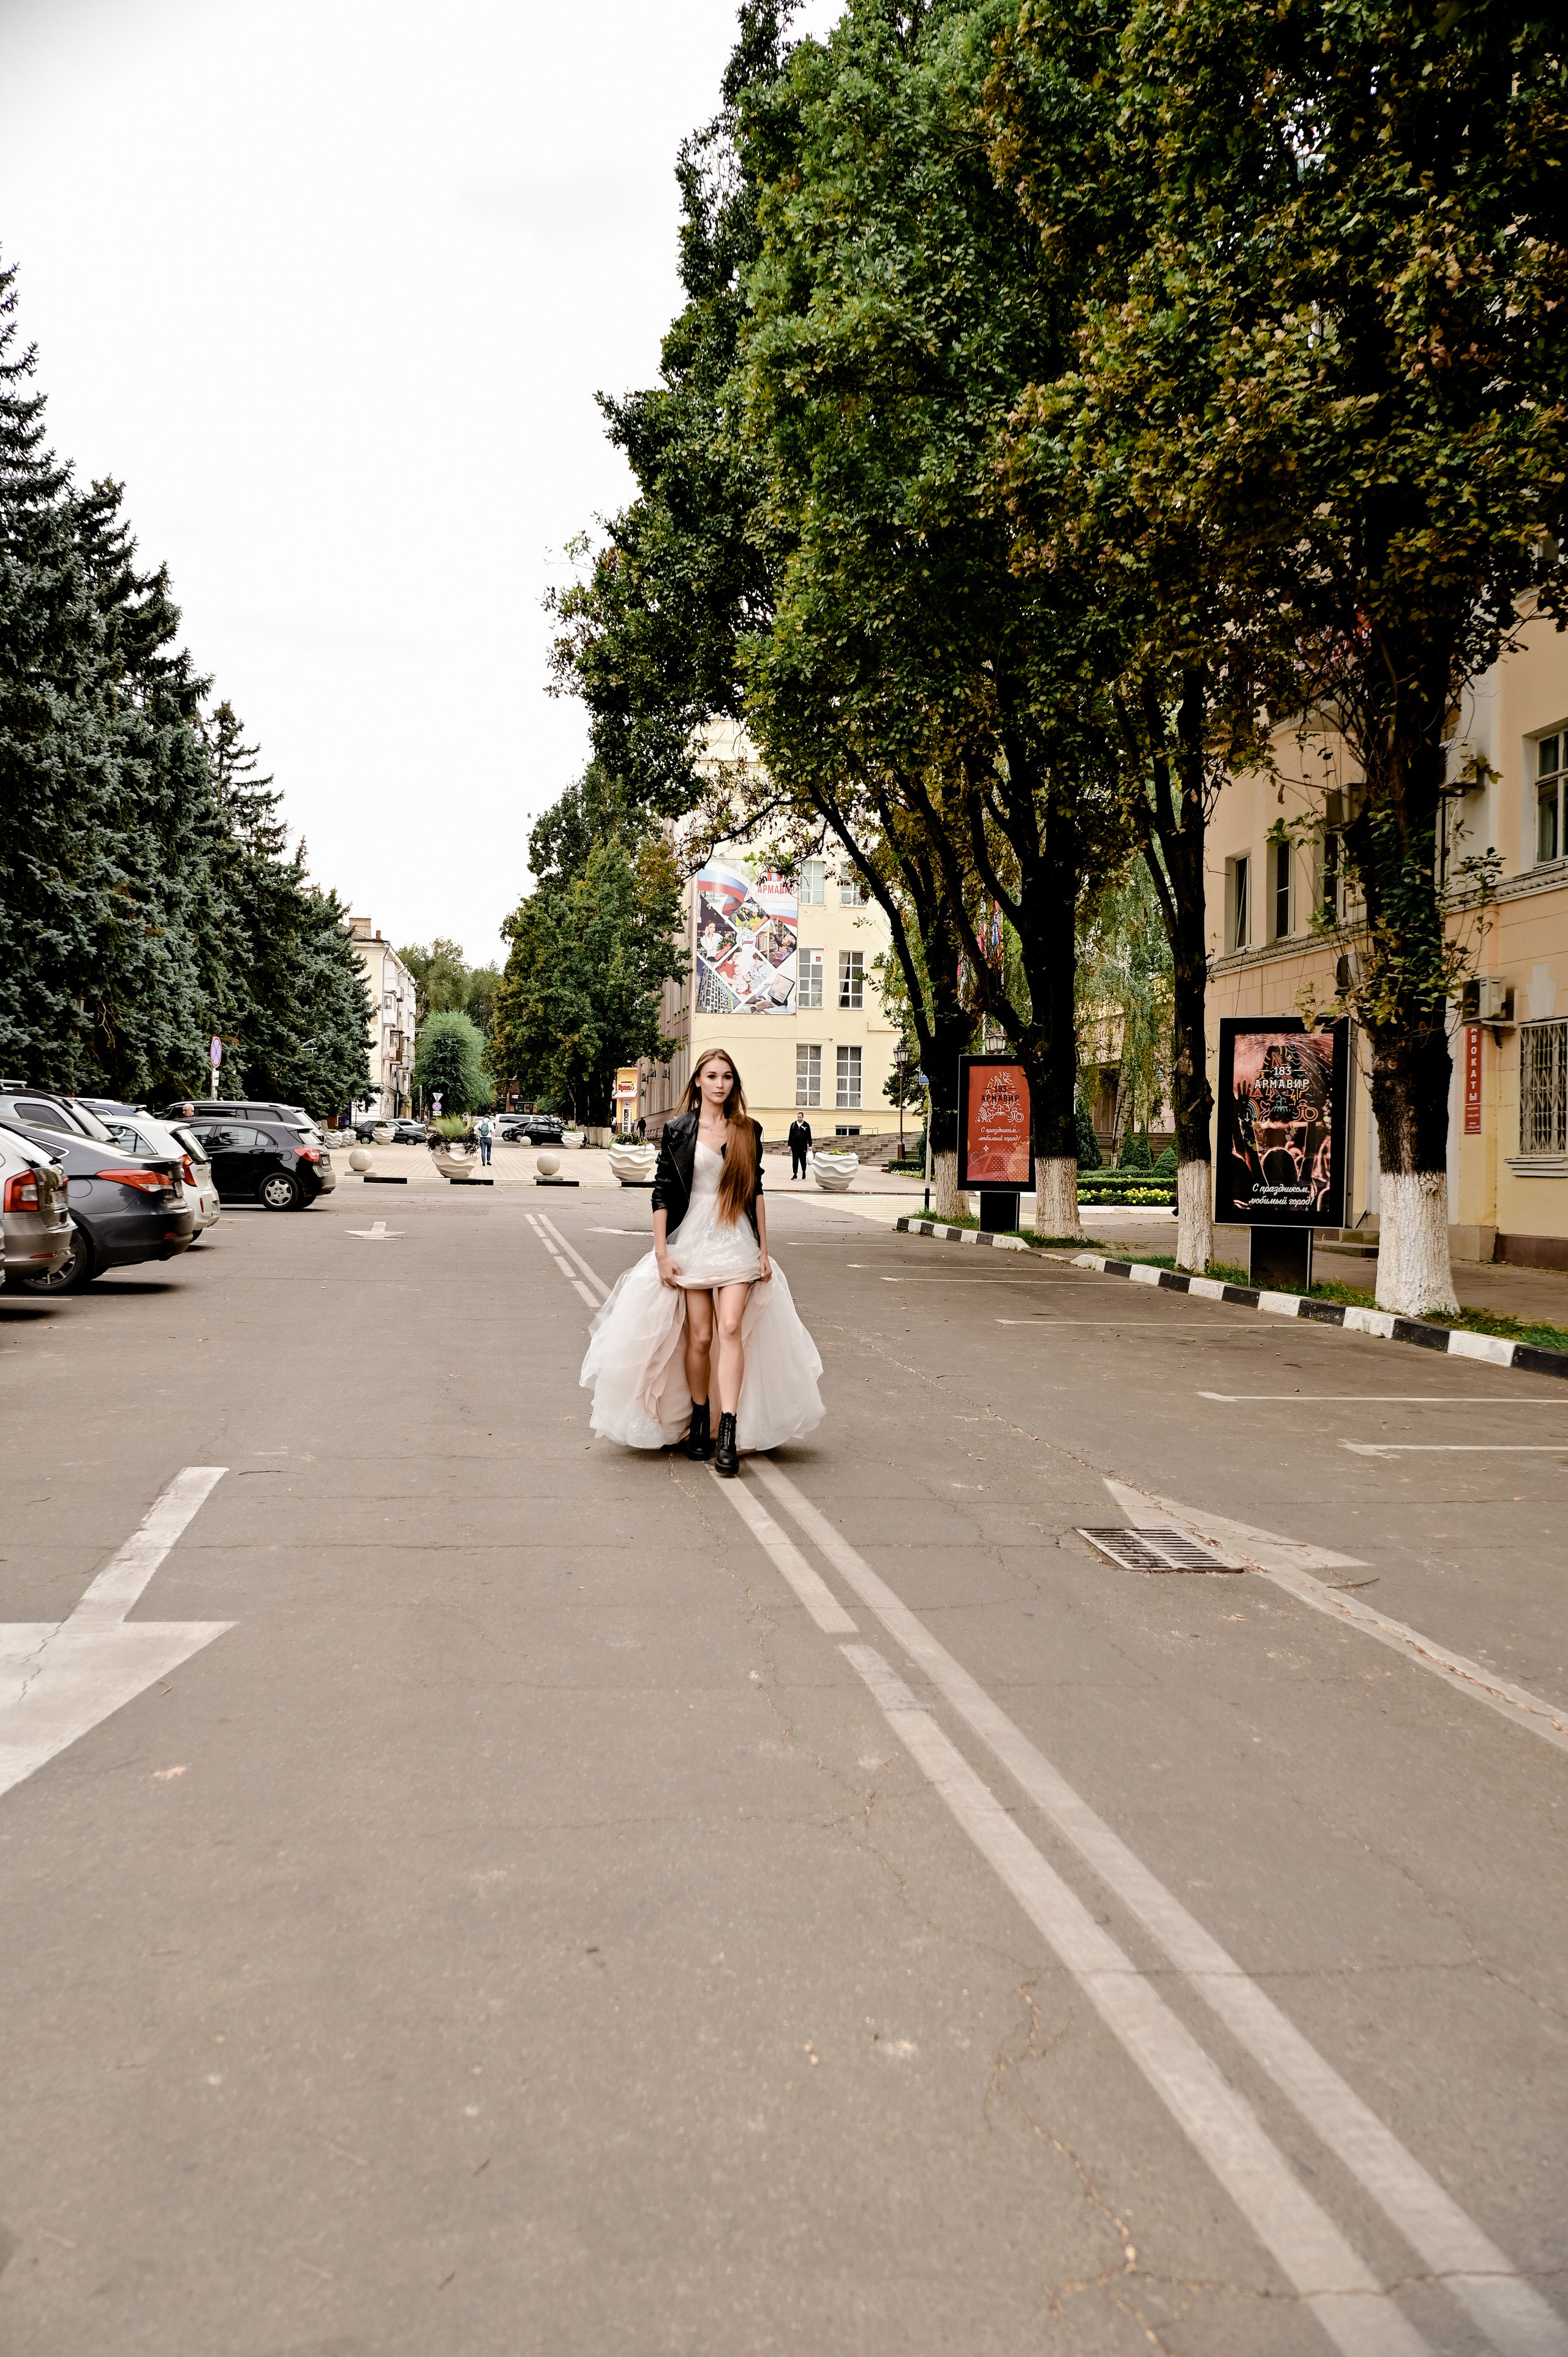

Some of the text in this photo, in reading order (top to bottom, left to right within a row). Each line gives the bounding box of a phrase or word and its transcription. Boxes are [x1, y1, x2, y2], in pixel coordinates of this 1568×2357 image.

[758, 885, 795, 894] АРМАВИР
[1273, 1066, 1292, 1076] 183
[1254, 1079, 1310, 1089] АРМАВИР
[1253, 1183, 1259, 1192] С
[1248, 1195, 1314, 1207] любимый город!
